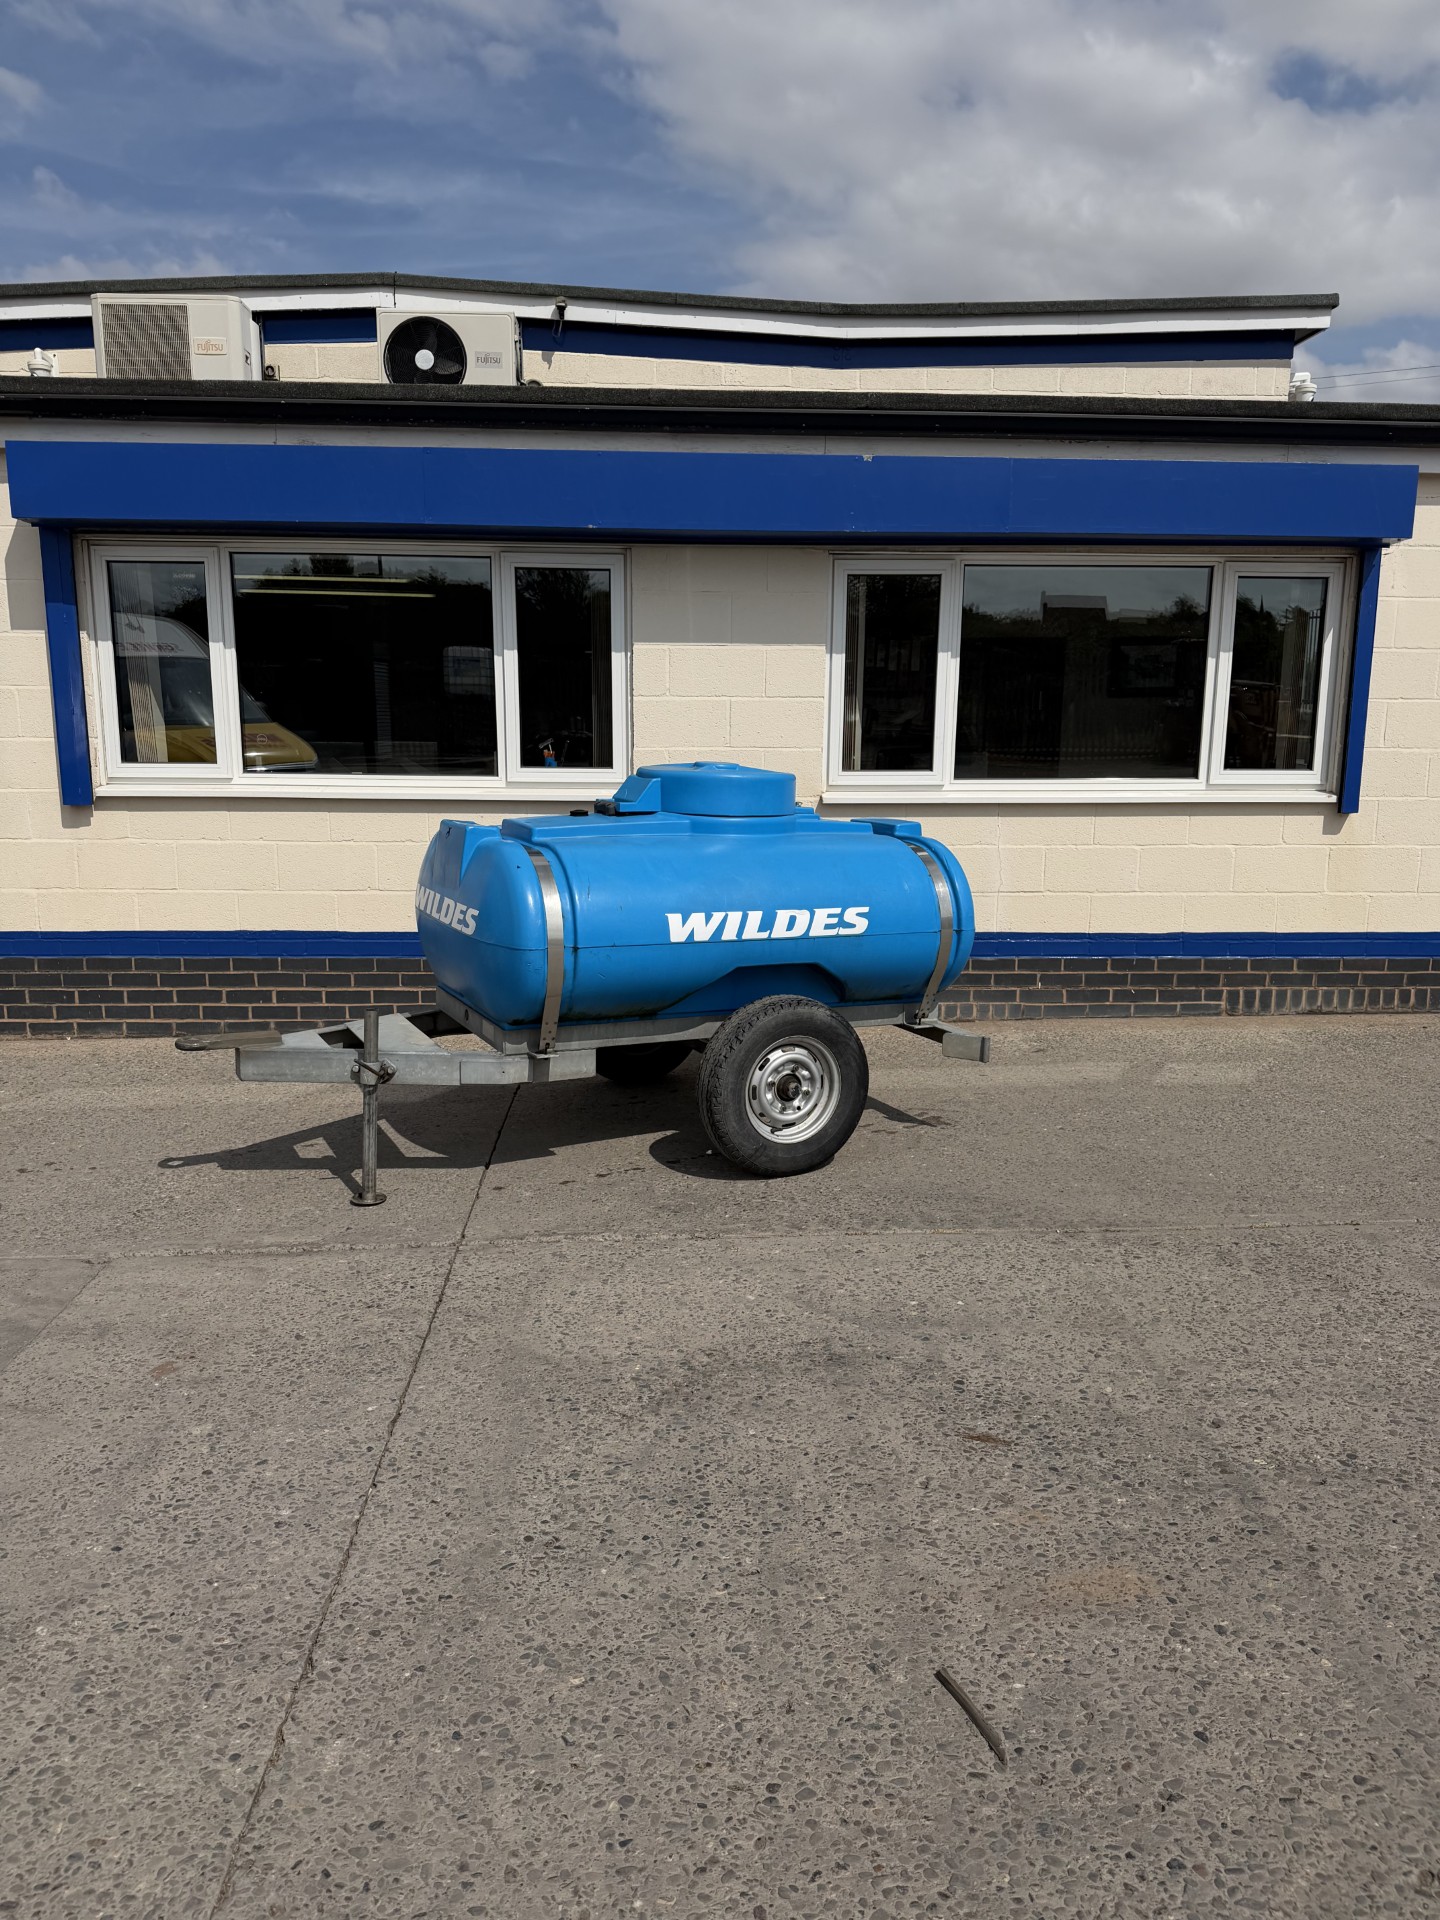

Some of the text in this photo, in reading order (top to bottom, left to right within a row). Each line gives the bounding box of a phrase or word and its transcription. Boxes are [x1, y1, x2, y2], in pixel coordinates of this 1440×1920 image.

[196, 339, 224, 353] FUJITSU
[476, 353, 501, 365] FUJITSU
[415, 883, 480, 935] WILDES
[665, 906, 870, 943] WILDES
